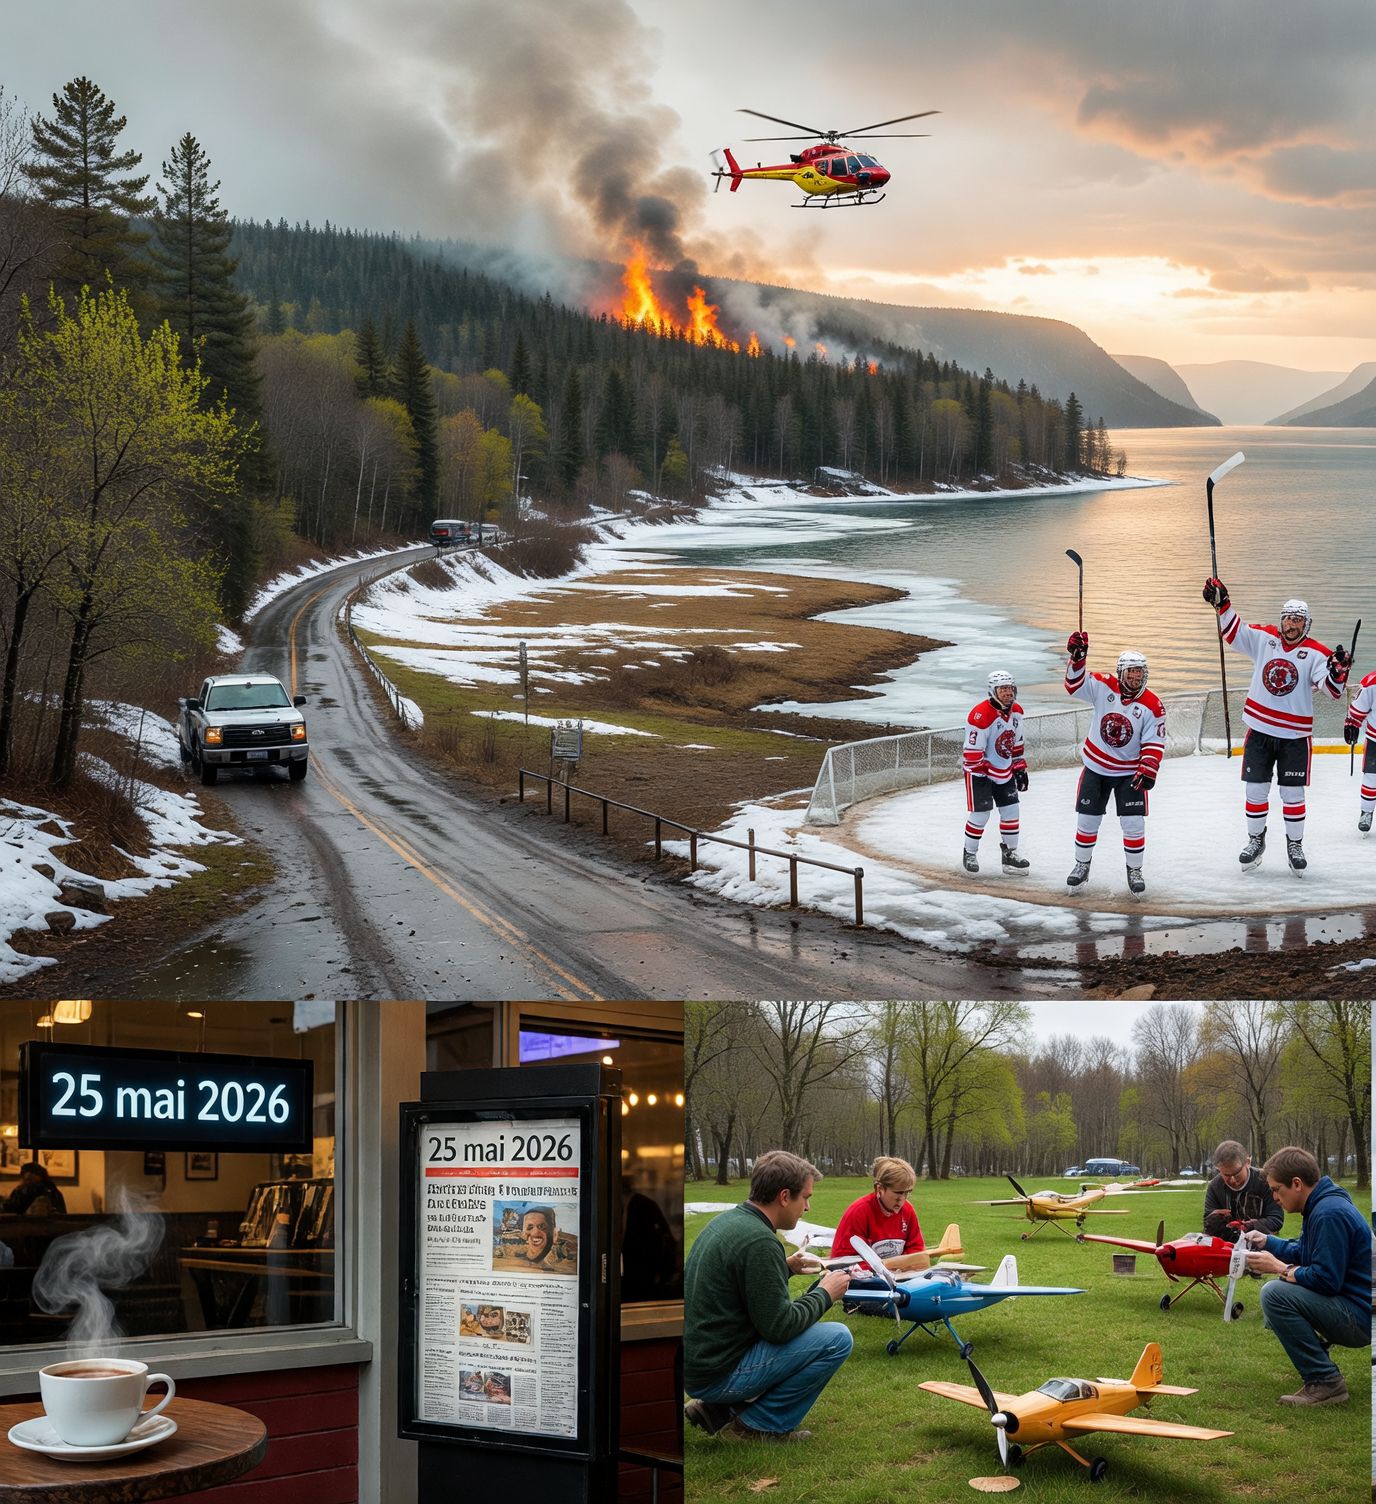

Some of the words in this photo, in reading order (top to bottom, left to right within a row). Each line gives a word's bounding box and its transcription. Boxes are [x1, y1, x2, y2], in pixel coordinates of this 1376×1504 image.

[51, 1071, 103, 1117] 25
[116, 1078, 185, 1120] mai
[197, 1079, 290, 1124] 2026
[428, 1136, 457, 1162] 25
[464, 1134, 505, 1162] mai
[511, 1133, 574, 1162] 2026
